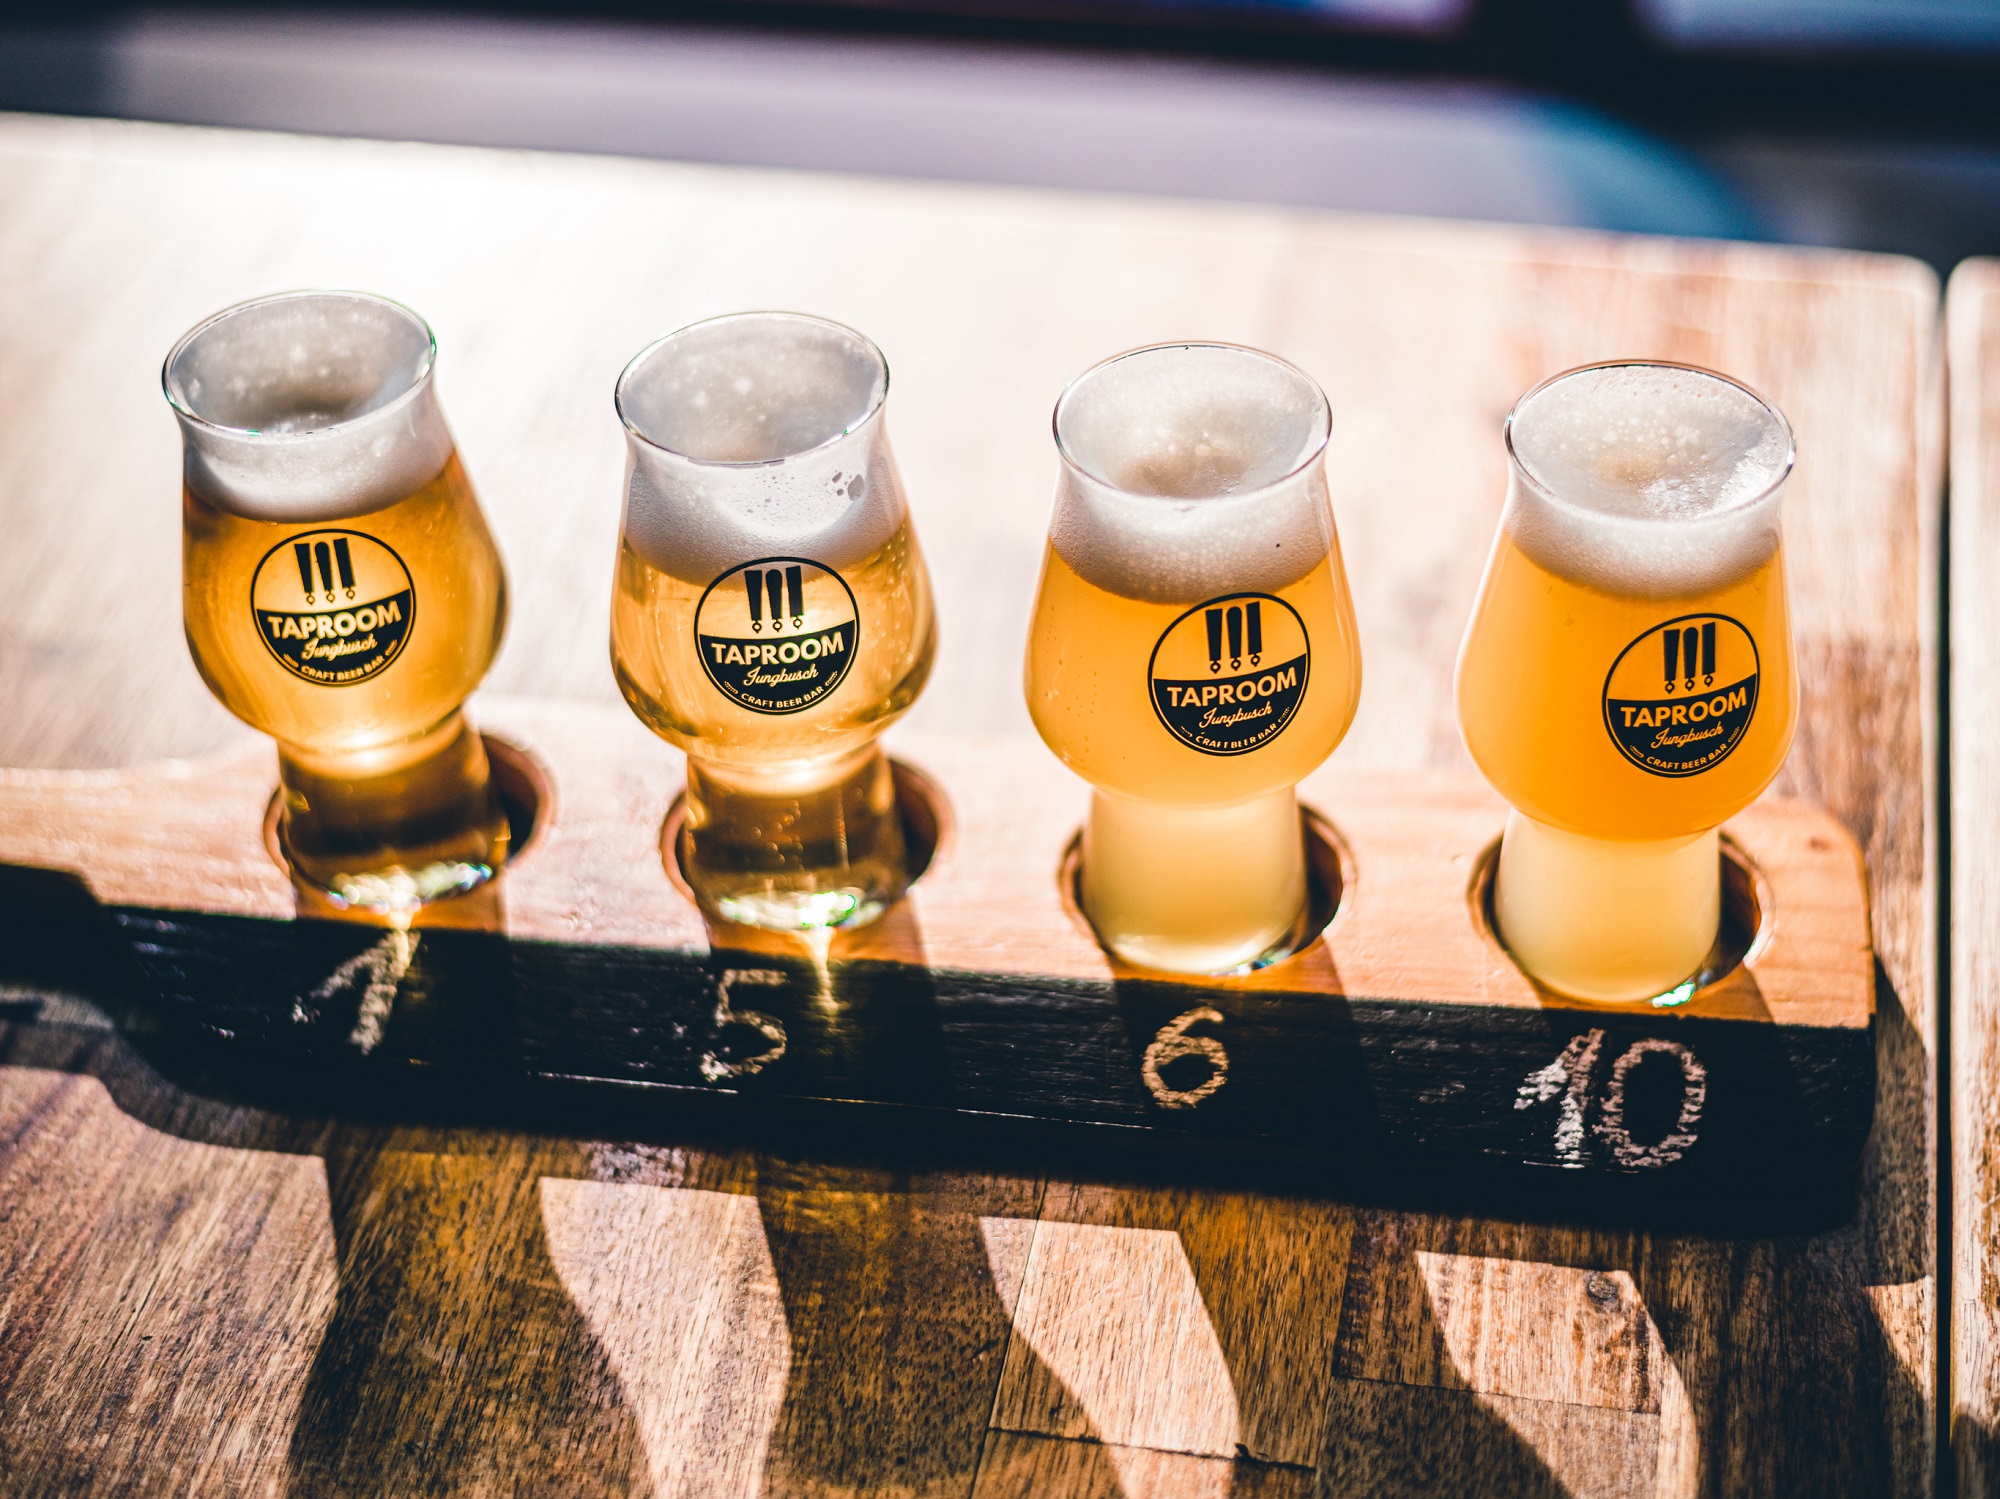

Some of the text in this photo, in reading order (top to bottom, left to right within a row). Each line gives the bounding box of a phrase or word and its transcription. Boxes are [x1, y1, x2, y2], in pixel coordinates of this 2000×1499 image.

[268, 600, 402, 639] TAPROOM
[302, 636, 378, 660] Jungbusch
[712, 631, 845, 666] TAPROOM
[300, 654, 385, 681] CRAFT BEER BAR
[743, 667, 819, 687] Jungbusch
[742, 686, 824, 708] CRAFT BEER BAR
[1167, 666, 1298, 707] TAPROOM
[1199, 705, 1272, 728] Jungbusch
[1621, 686, 1747, 728] TAPROOM
[1196, 723, 1277, 749] CRAFT BEER BAR
[1651, 725, 1724, 748] Jungbusch
[1646, 743, 1727, 770] CRAFT BEER BAR
[290, 934, 418, 1052] 1
[697, 970, 788, 1082] 5
[1142, 1007, 1231, 1109] 6
[1514, 1030, 1707, 1169] 10
